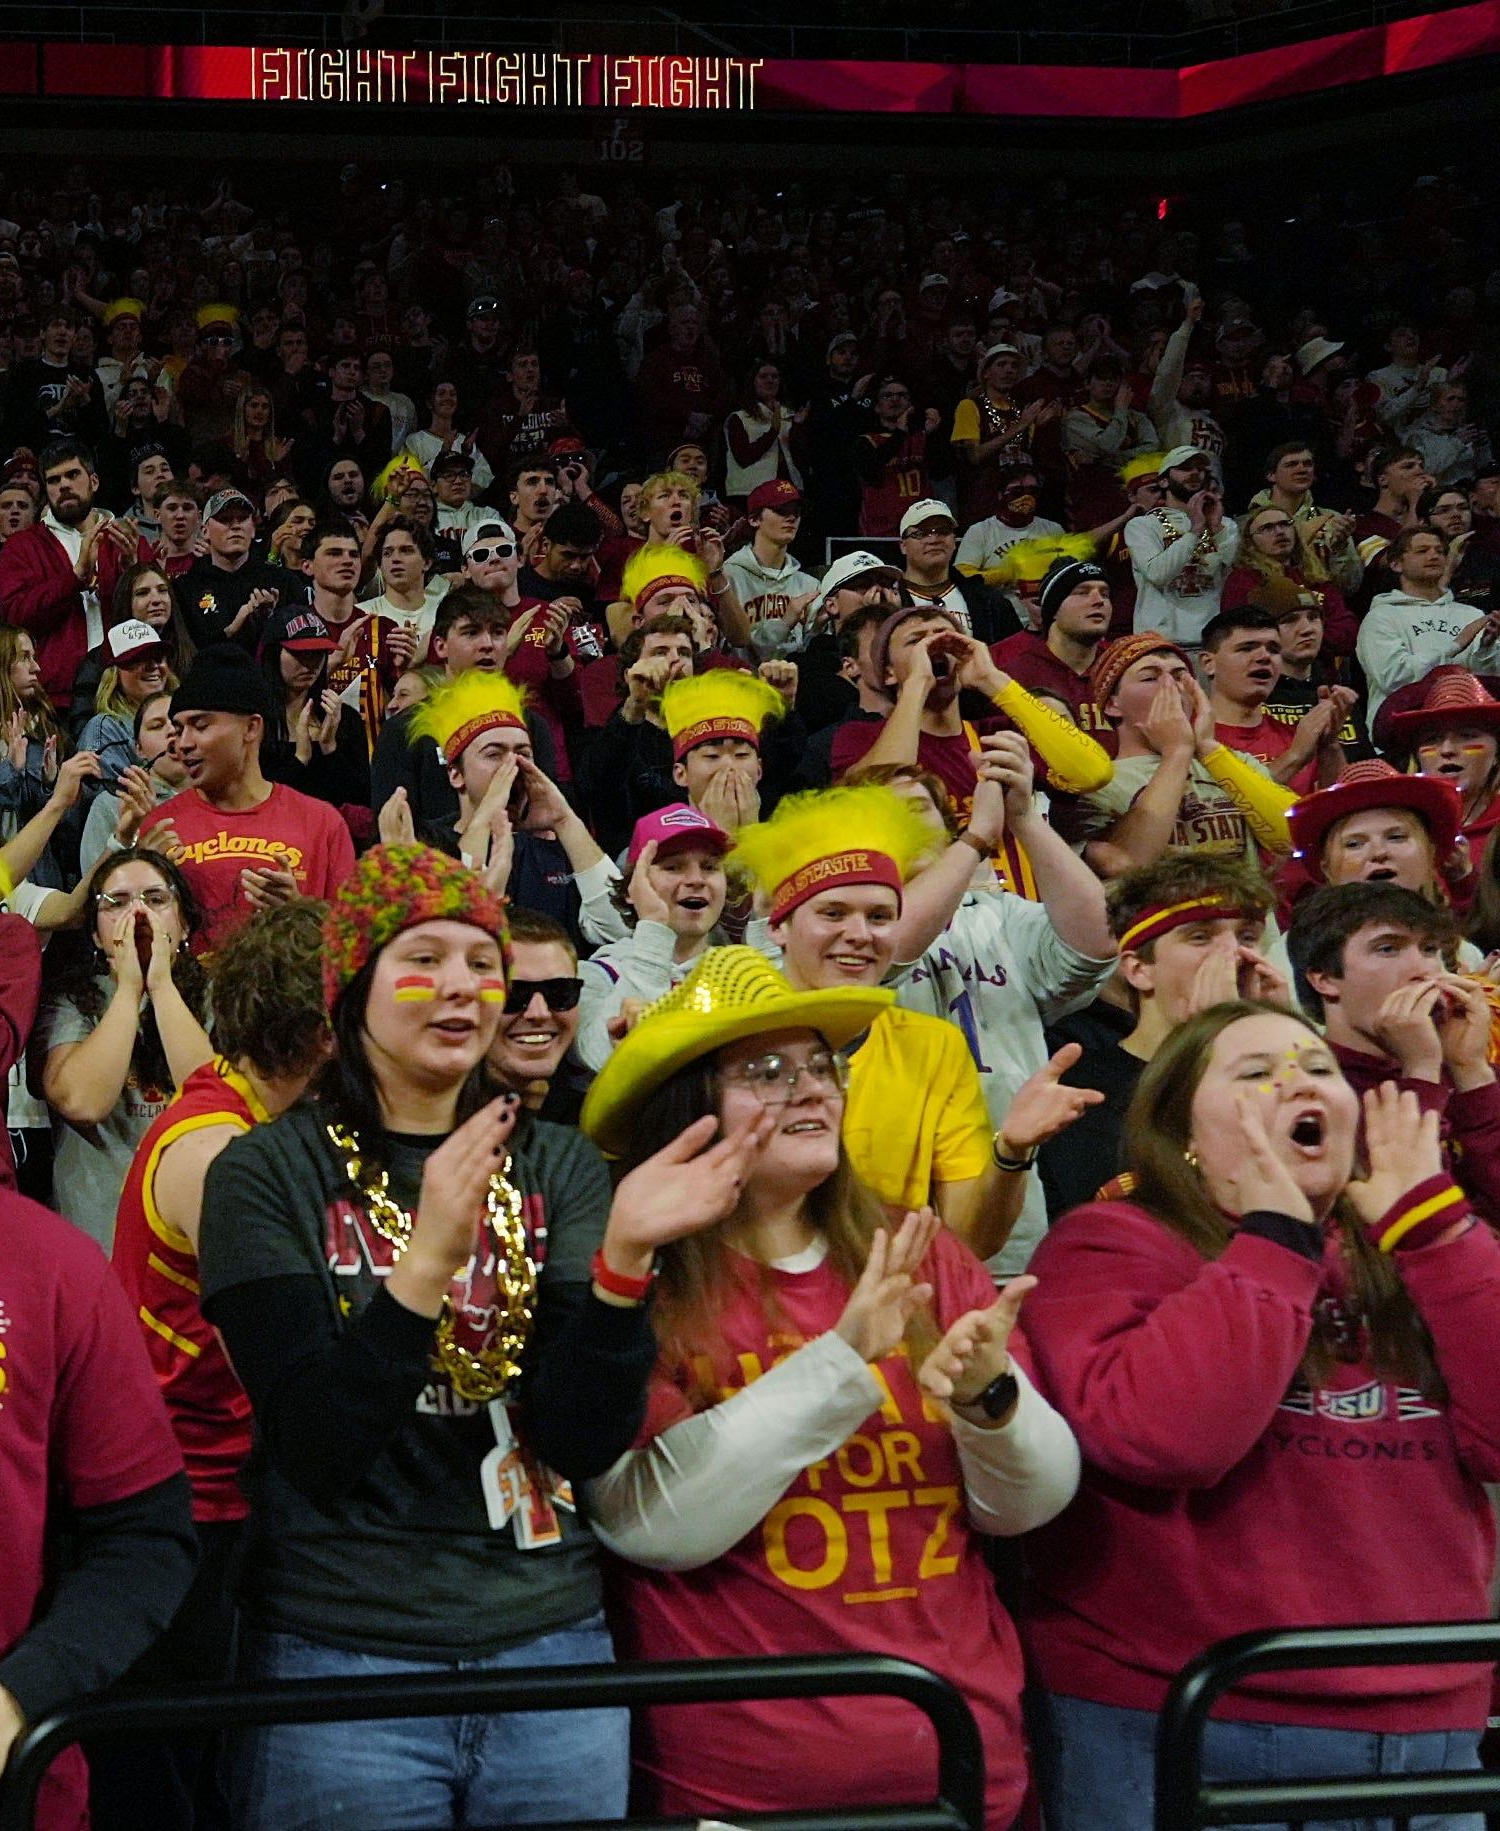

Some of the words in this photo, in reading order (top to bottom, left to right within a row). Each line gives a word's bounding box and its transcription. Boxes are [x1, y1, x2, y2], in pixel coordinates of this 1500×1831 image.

[251, 47, 416, 102] FIGHT
[428, 51, 591, 106] FIGHT
[604, 56, 764, 110] FIGHT
[600, 139, 644, 161] 102
[898, 469, 921, 497] 10
[1412, 620, 1461, 638] AMES
[796, 853, 874, 890] STATE
[949, 990, 993, 1072] 1
[1265, 1433, 1438, 1463] YCLONES
[763, 1486, 961, 1590] OTZ
